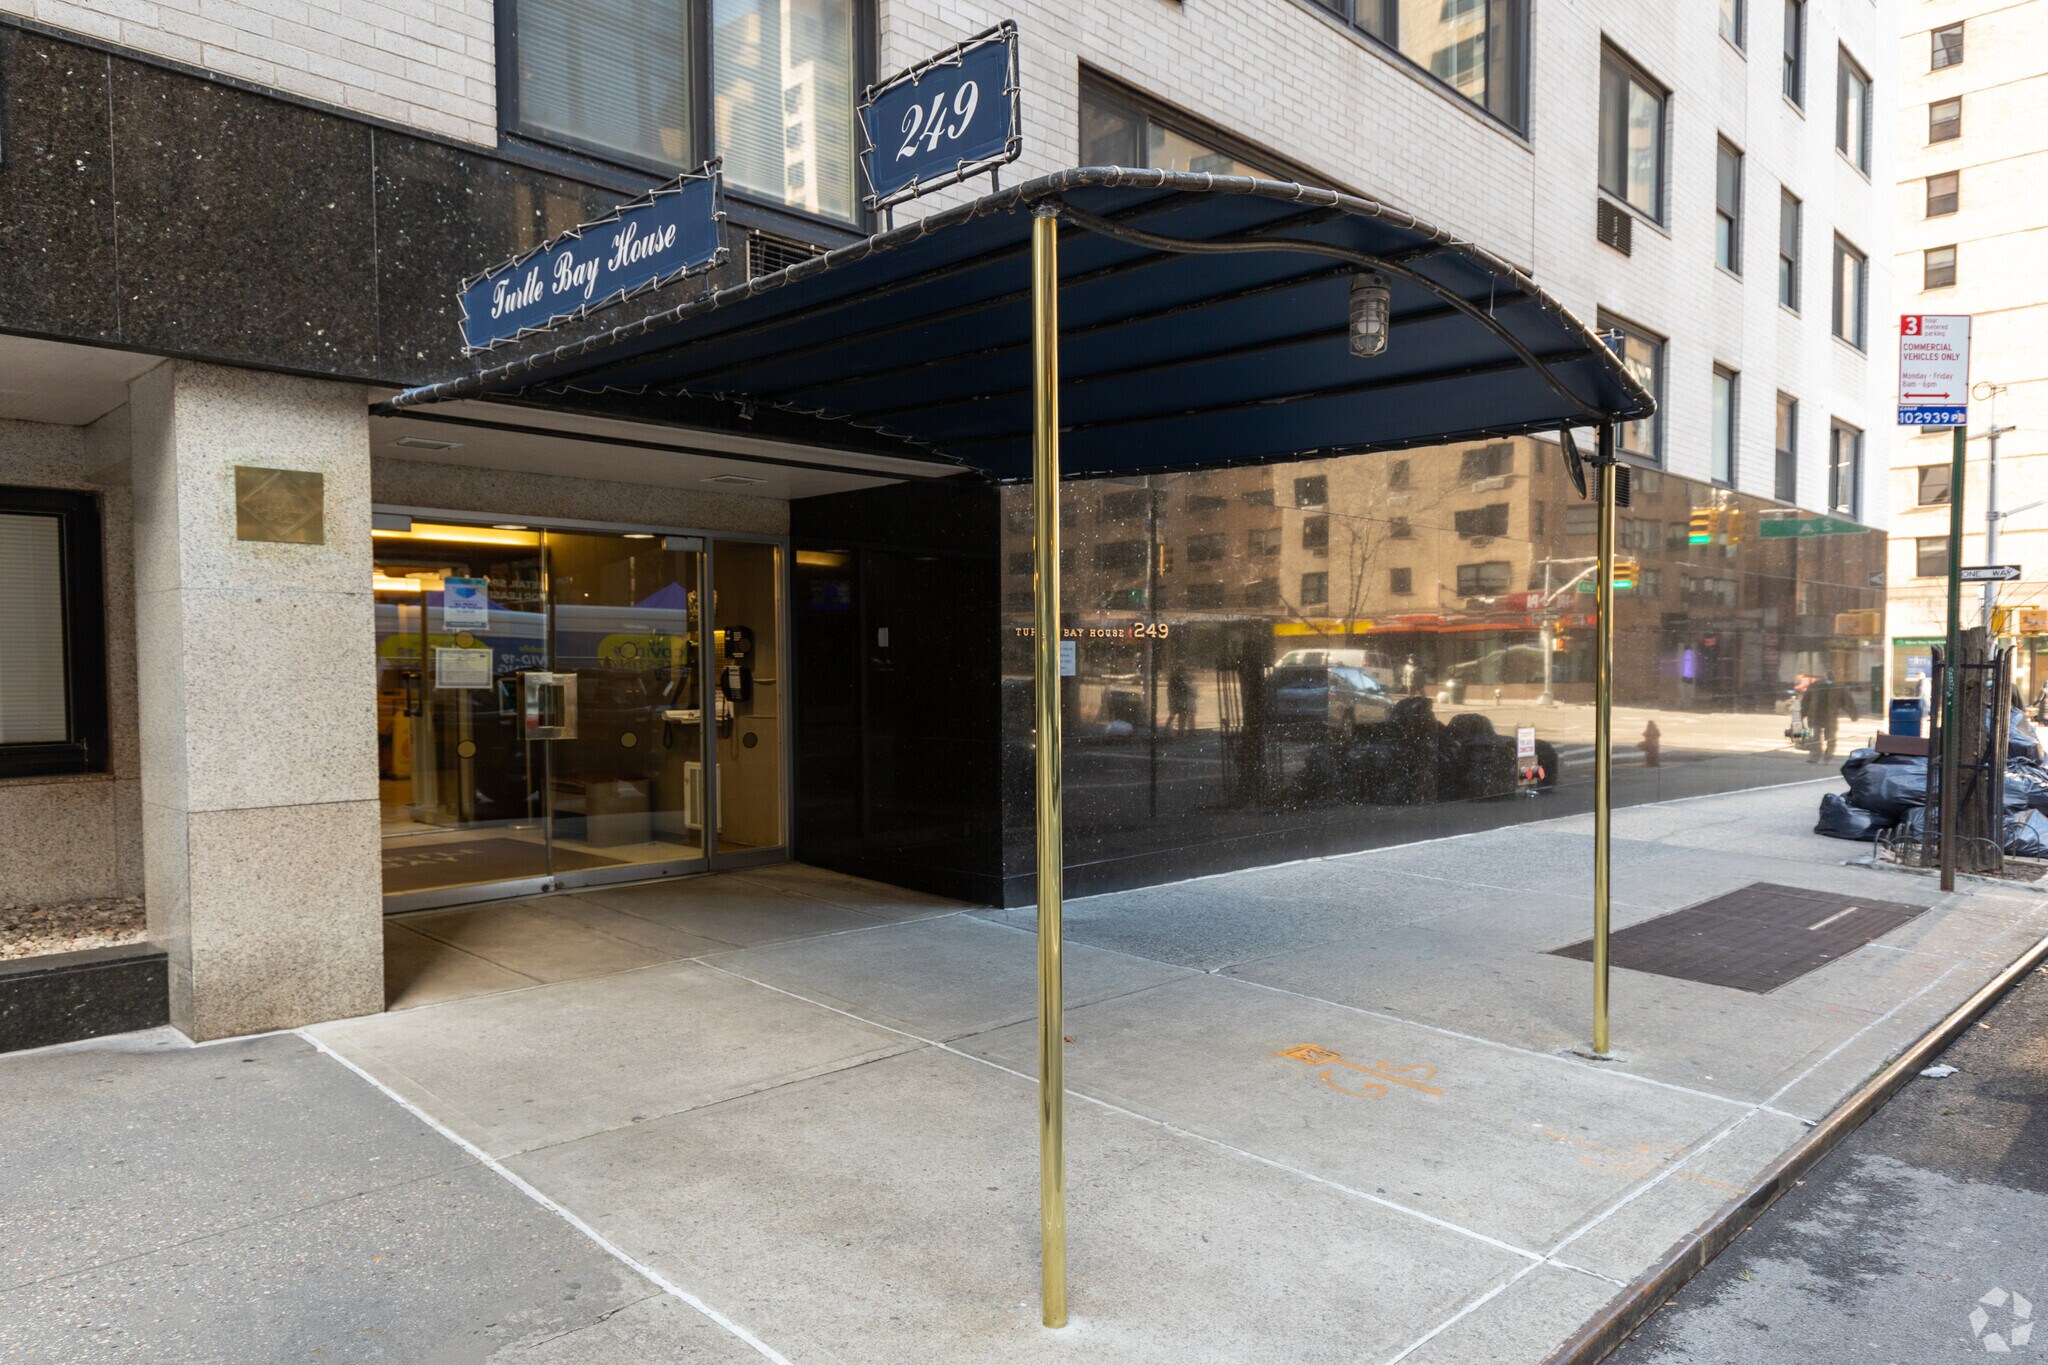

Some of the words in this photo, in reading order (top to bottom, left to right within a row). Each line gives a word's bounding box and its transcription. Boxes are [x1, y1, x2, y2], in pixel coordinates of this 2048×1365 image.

[894, 80, 979, 162] 249
[491, 265, 545, 320] Turtle
[551, 250, 600, 300] Bay
[607, 221, 677, 272] House
[1905, 316, 1918, 335] 3
[1903, 343, 1953, 352] COMMERCIAL
[1903, 352, 1939, 361] VEHICLES
[1941, 352, 1960, 361] ONLY
[1902, 372, 1928, 381] Monday
[1933, 372, 1953, 381] Friday
[1922, 381, 1938, 389] 6pm
[1899, 412, 1950, 424] 102939
[1992, 568, 2013, 577] WAY
[1063, 628, 1084, 637] BAY
[1089, 628, 1125, 638] HOUSE
[1133, 622, 1169, 639] 249
